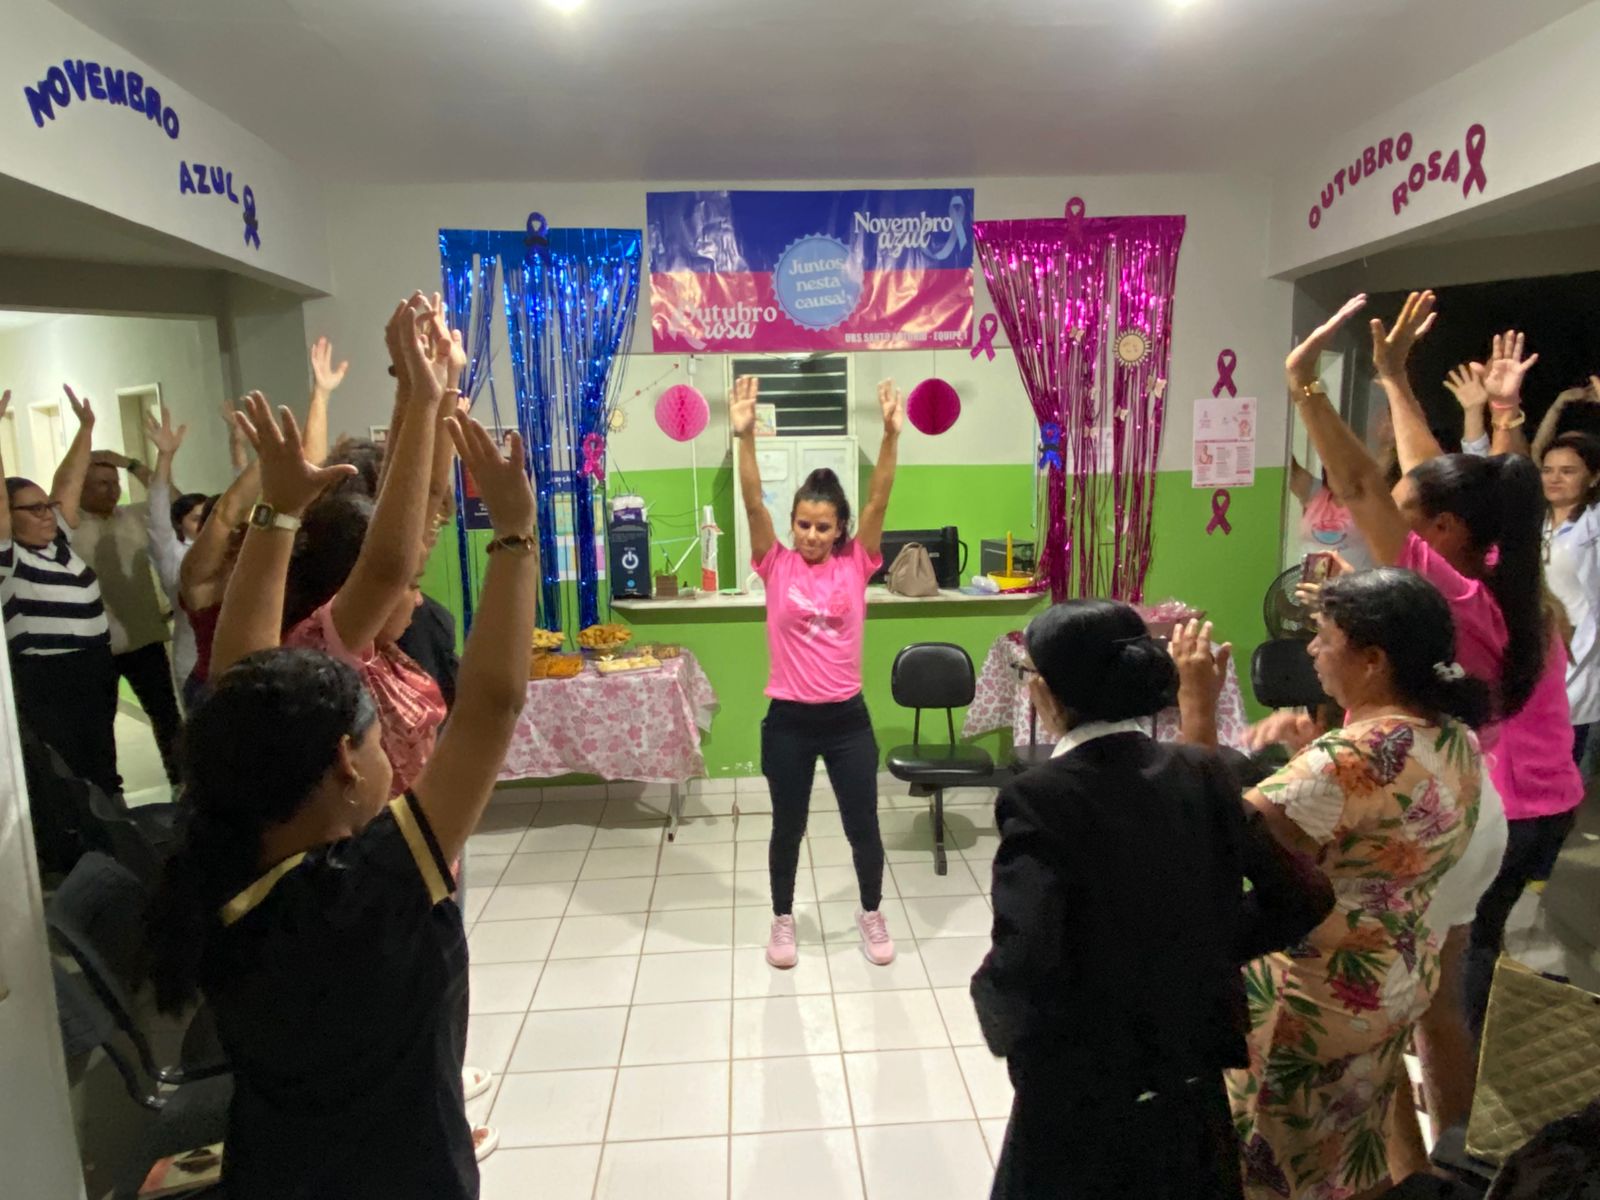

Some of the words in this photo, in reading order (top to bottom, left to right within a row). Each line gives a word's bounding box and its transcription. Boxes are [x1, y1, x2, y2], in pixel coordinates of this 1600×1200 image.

[24, 59, 180, 139] NOVEMBRO
[179, 160, 239, 204] AZUL
[1308, 131, 1413, 229] OUTUBRO
[1392, 149, 1460, 216] ROSA
[853, 211, 953, 234] Novembro
[878, 224, 931, 258] azul
[788, 258, 844, 275] Juntos
[795, 276, 841, 292] nesta
[702, 319, 757, 340] rosa
